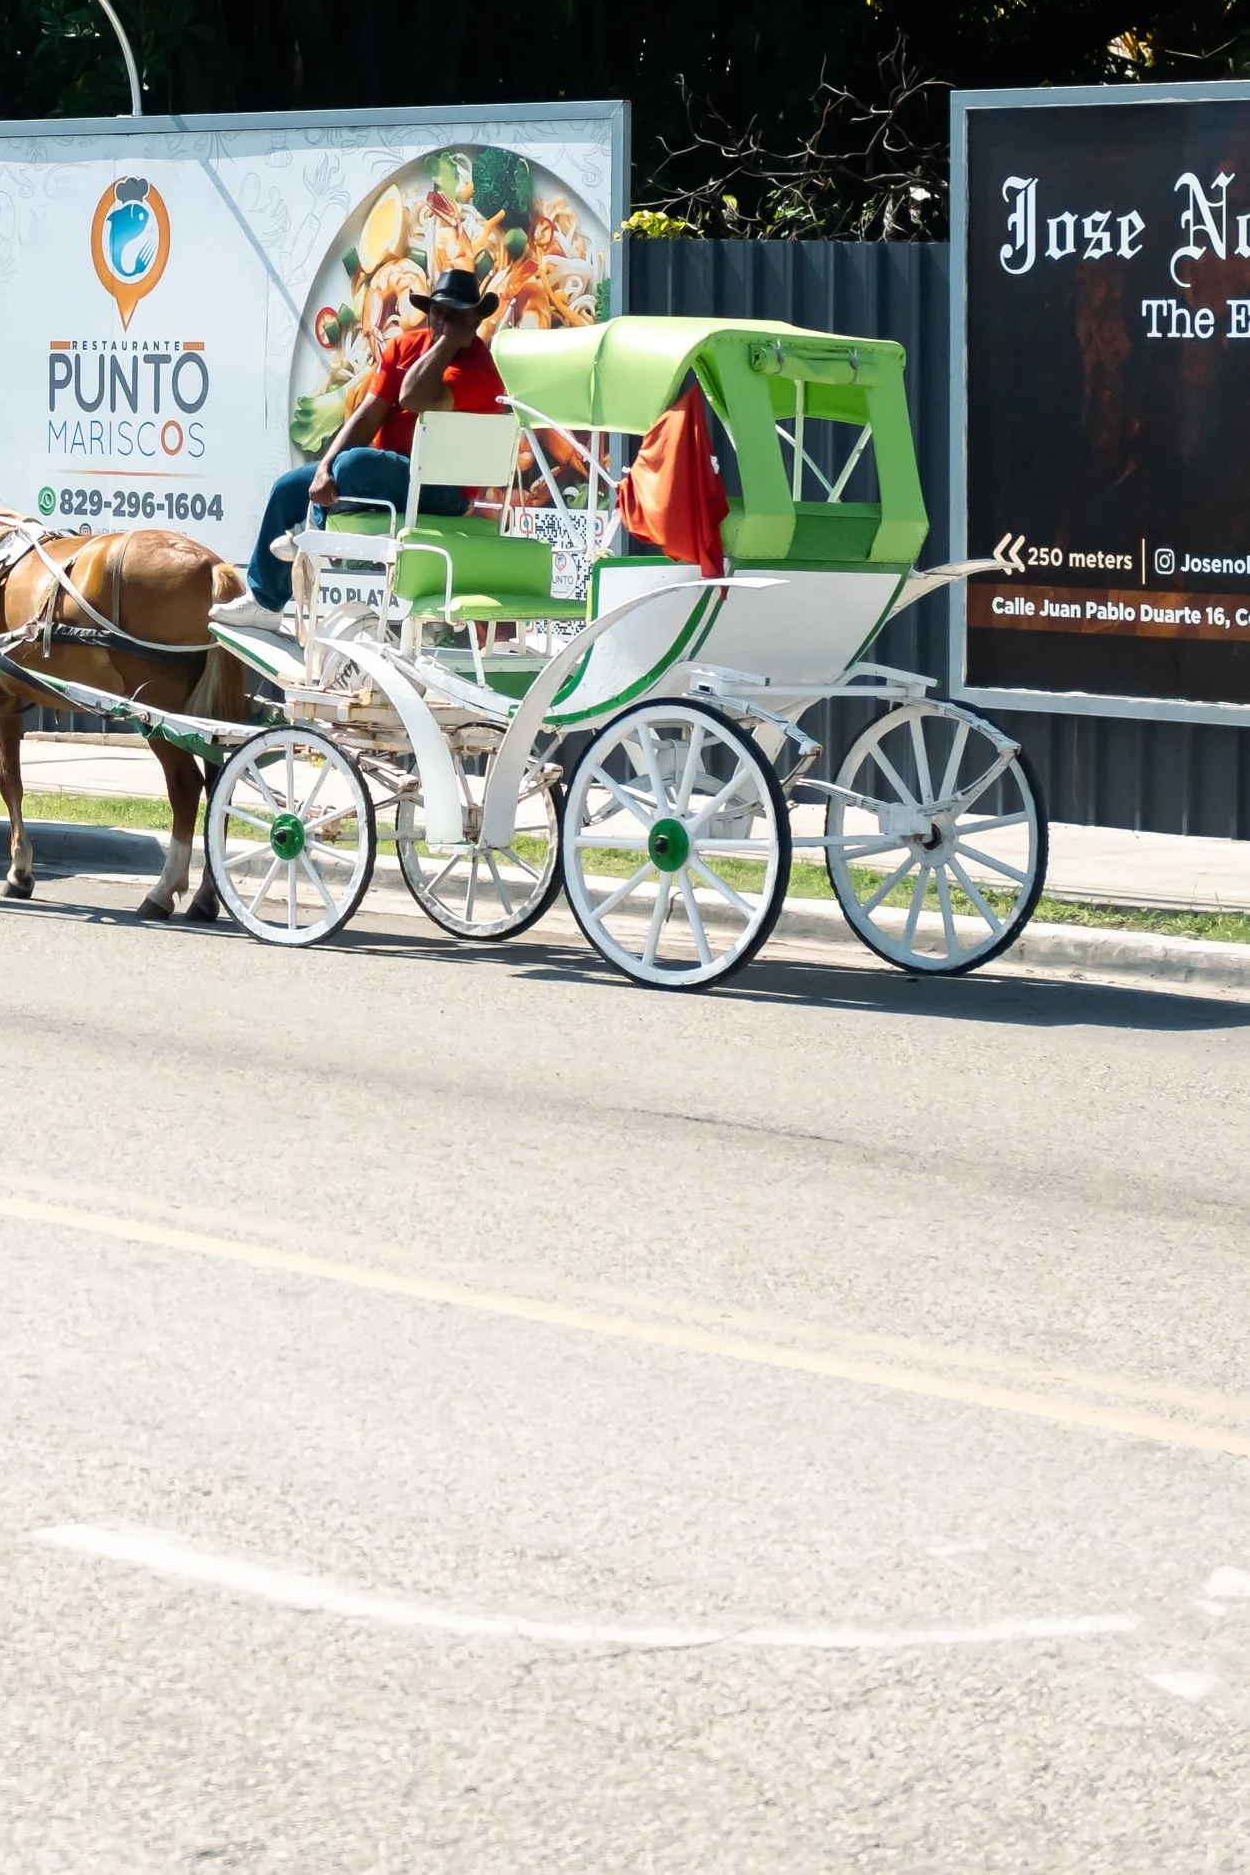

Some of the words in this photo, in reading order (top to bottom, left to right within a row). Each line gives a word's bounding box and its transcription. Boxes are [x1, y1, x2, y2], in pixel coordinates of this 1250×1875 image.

[1000, 176, 1146, 275] Jose
[1142, 299, 1215, 338] The
[72, 340, 181, 351] RESTAURANTE
[49, 352, 209, 415] PUNTO
[48, 420, 205, 458] MARISCOS
[59, 488, 224, 521] 829-296-1604
[1027, 547, 1063, 567] 250
[1068, 551, 1133, 570] meters
[991, 596, 1035, 616] Calle
[1039, 599, 1081, 619] Juan
[1085, 601, 1136, 622] Pablo
[1140, 604, 1202, 625] Duarte
[1205, 606, 1231, 629] 16,
[1235, 607, 1250, 627] C
